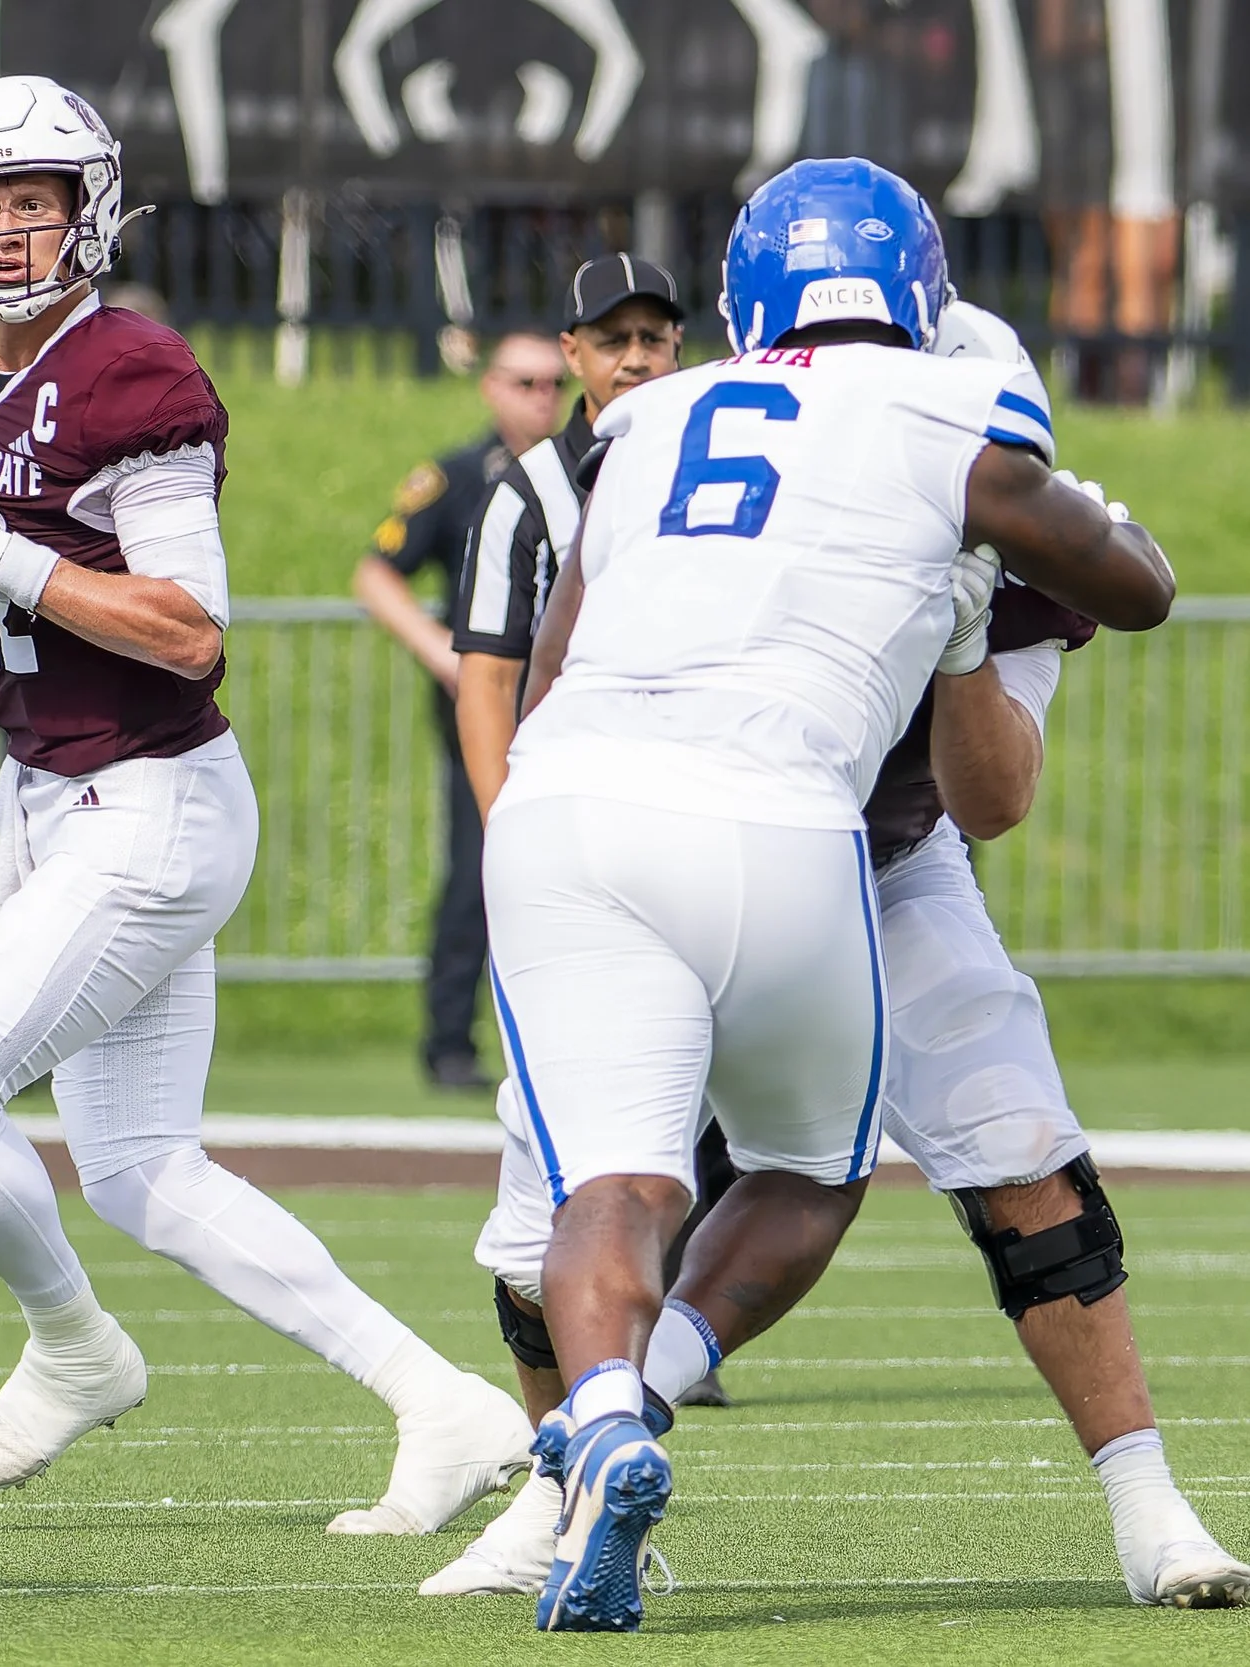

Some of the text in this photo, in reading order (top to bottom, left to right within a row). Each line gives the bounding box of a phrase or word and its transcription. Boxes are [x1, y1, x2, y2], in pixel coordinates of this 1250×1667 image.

[807, 288, 874, 308] VICIS
[32, 381, 59, 444] C
[656, 380, 802, 540] 6
